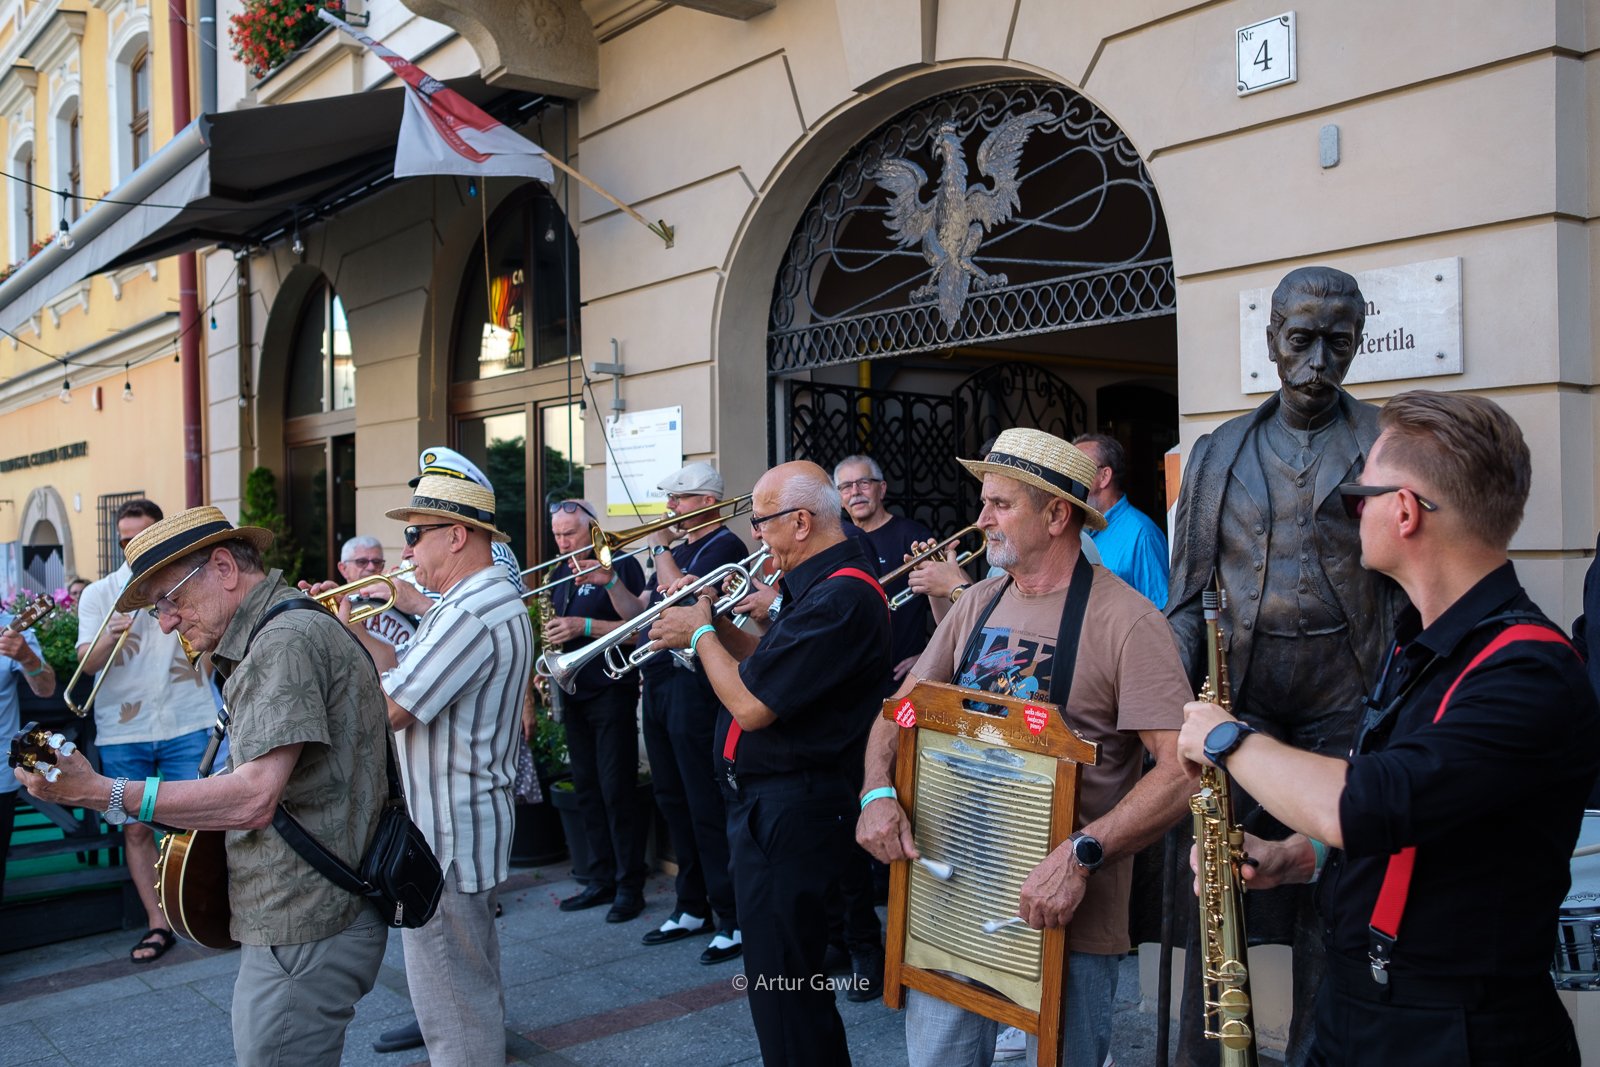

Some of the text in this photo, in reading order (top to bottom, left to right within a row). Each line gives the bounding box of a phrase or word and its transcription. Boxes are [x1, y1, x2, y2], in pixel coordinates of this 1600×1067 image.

[1241, 31, 1254, 43] Nr
[1253, 39, 1273, 72] 4
[1359, 326, 1416, 355] Tertila
